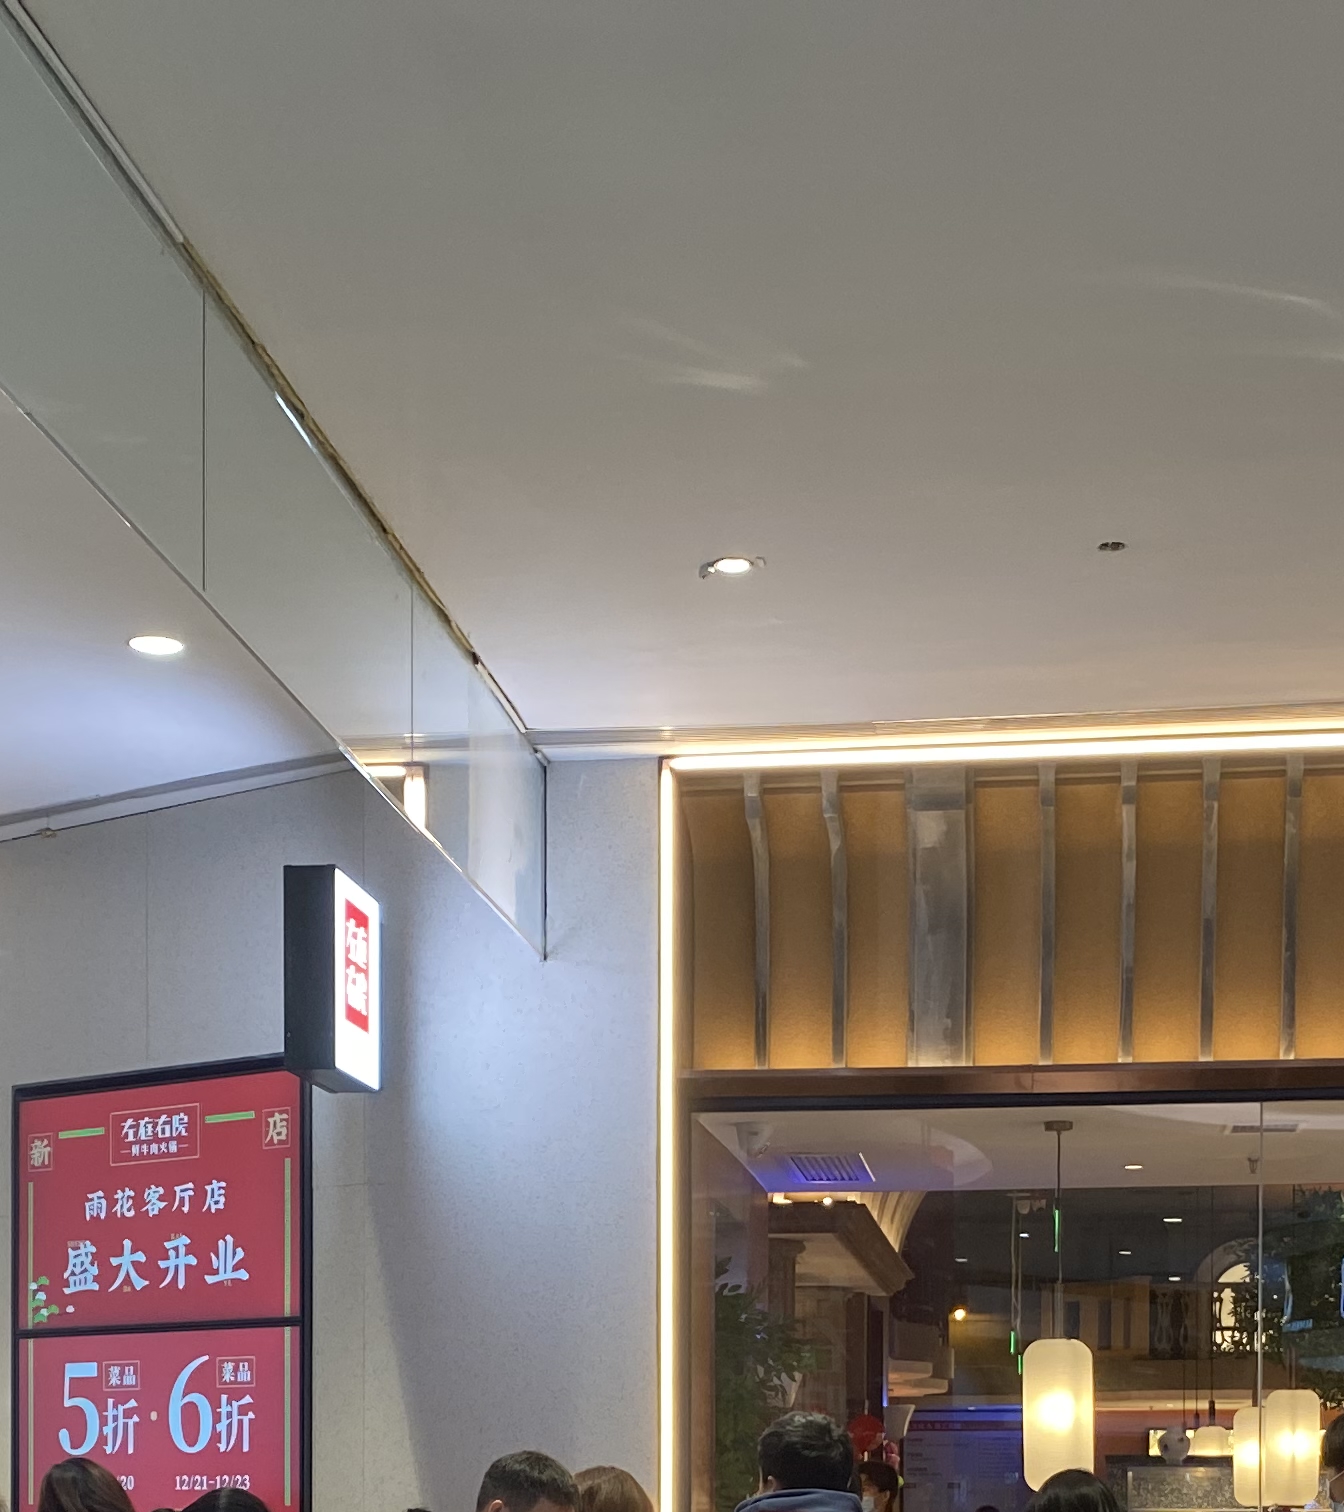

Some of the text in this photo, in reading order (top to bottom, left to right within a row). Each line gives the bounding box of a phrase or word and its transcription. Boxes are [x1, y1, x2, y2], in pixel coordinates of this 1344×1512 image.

[120, 1112, 189, 1142] 左庭右院
[264, 1111, 290, 1145] 店
[29, 1138, 52, 1168] 新
[84, 1178, 227, 1221] 雨花客厅店
[61, 1233, 250, 1294] 盛大开业
[107, 1364, 137, 1387] 菜品
[220, 1361, 252, 1383] 菜品
[174, 1474, 251, 1491] 12/21-12/23
